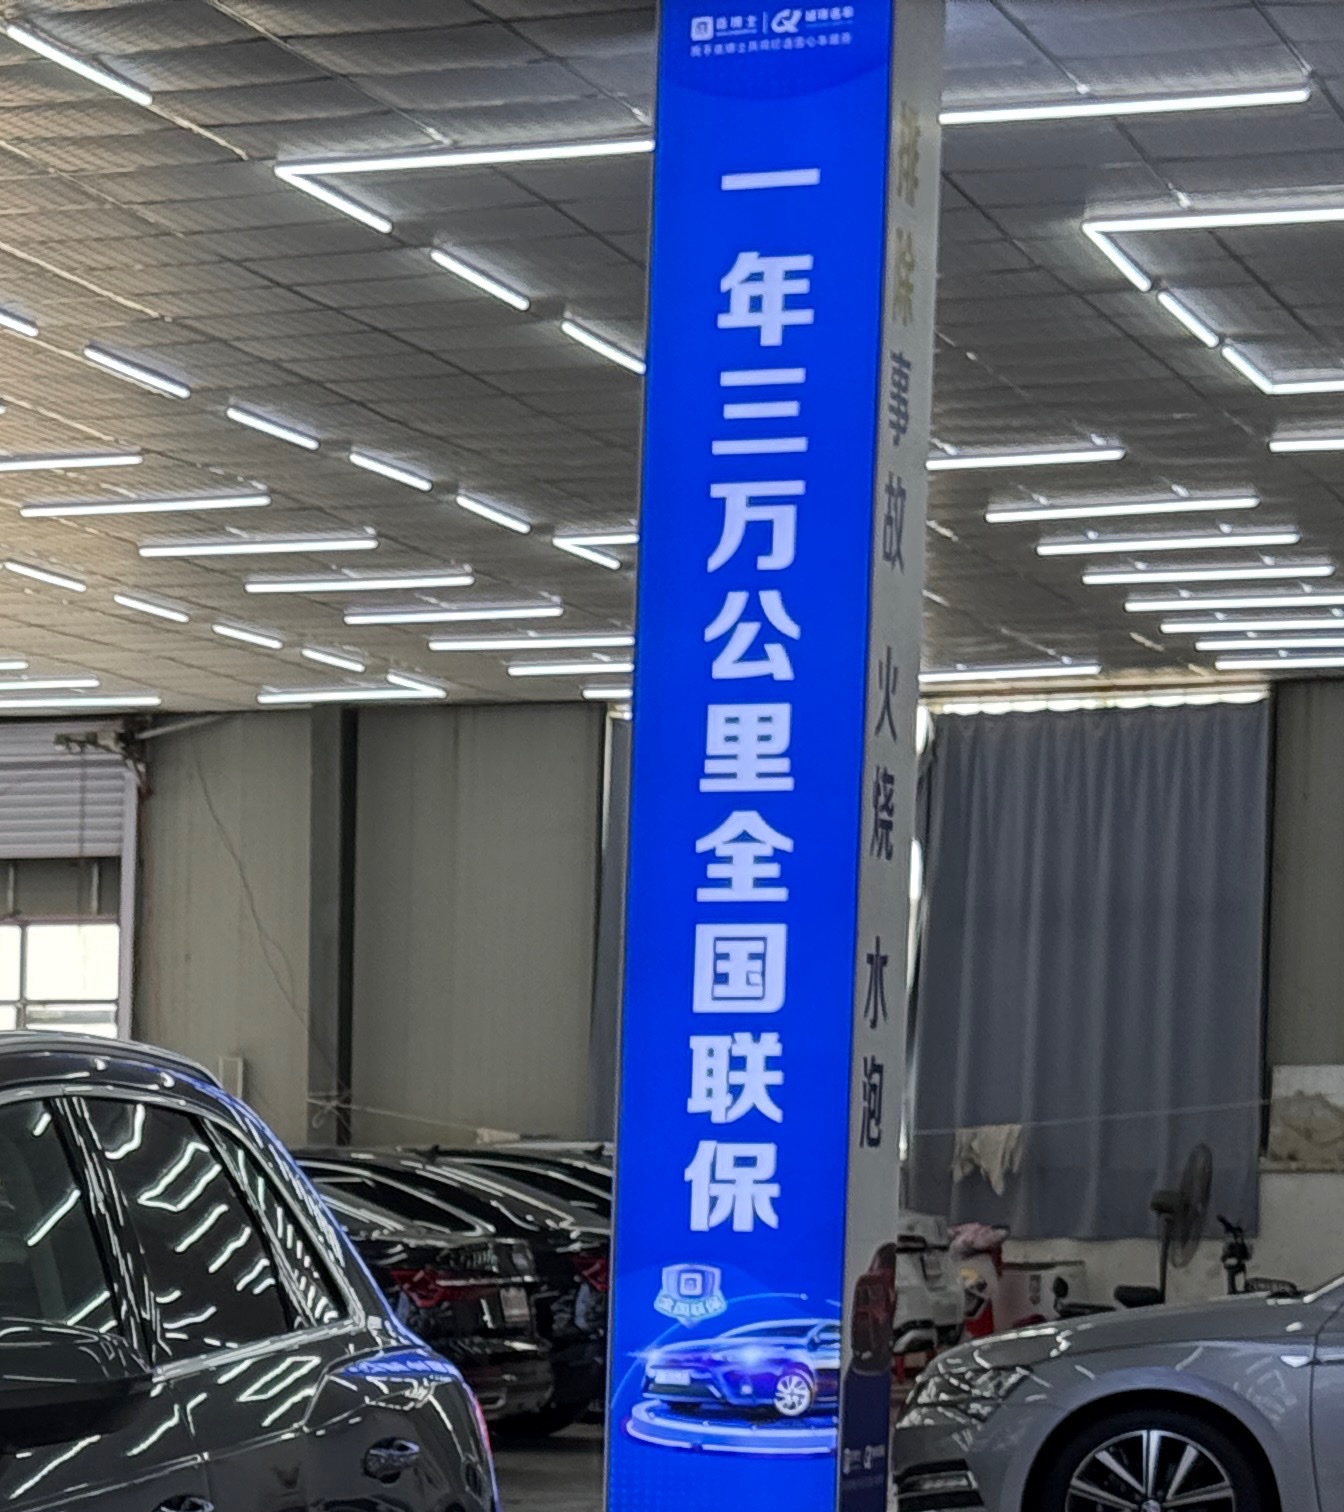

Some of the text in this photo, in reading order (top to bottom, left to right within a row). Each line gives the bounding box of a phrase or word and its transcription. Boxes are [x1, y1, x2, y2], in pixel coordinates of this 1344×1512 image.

[683, 168, 821, 1232] 一年三万公里全国联保
